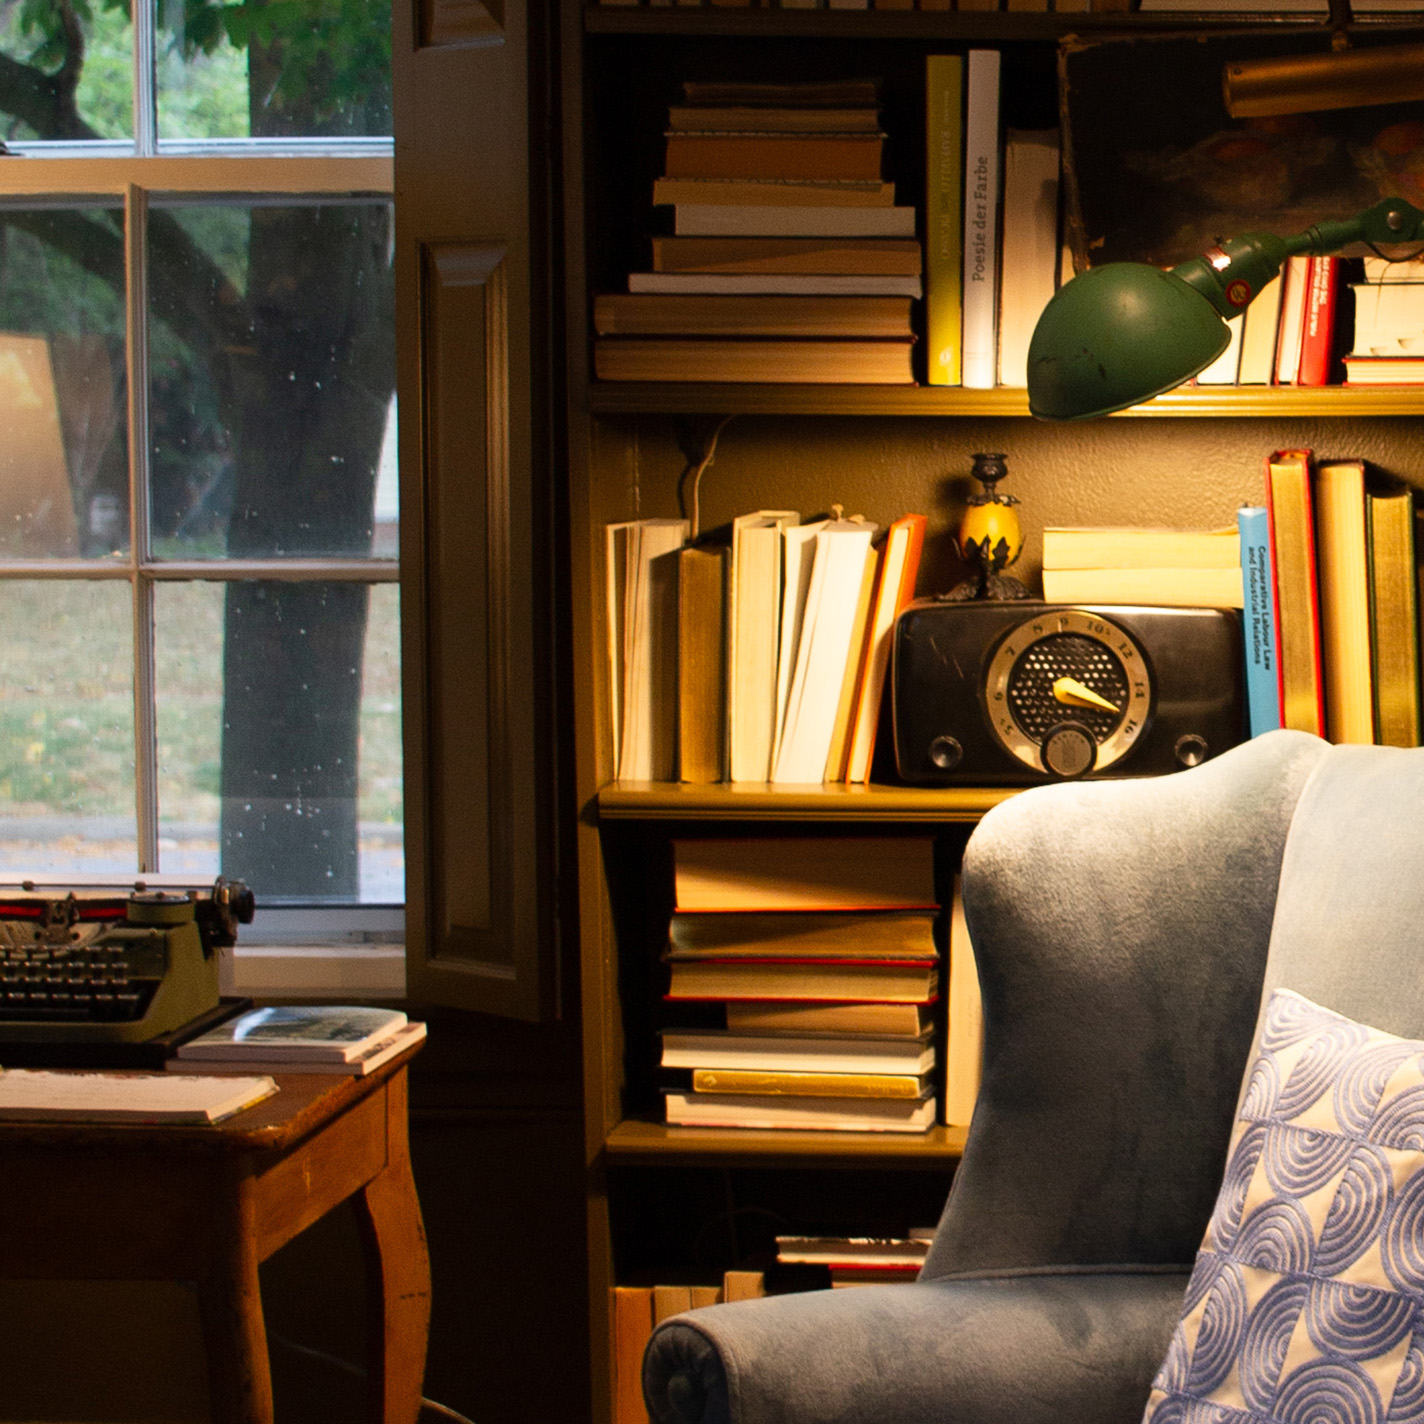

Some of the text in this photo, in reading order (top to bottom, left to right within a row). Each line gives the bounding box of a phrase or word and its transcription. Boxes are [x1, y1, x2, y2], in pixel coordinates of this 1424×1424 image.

[971, 155, 988, 283] Poesie der Farbe
[1248, 546, 1261, 665] and Industrial Relations
[1257, 545, 1272, 671] Comparative Labour Law
[1005, 646, 1016, 656] 7
[1117, 642, 1133, 659] 12
[1134, 681, 1145, 698] 14
[1123, 718, 1138, 735] 16
